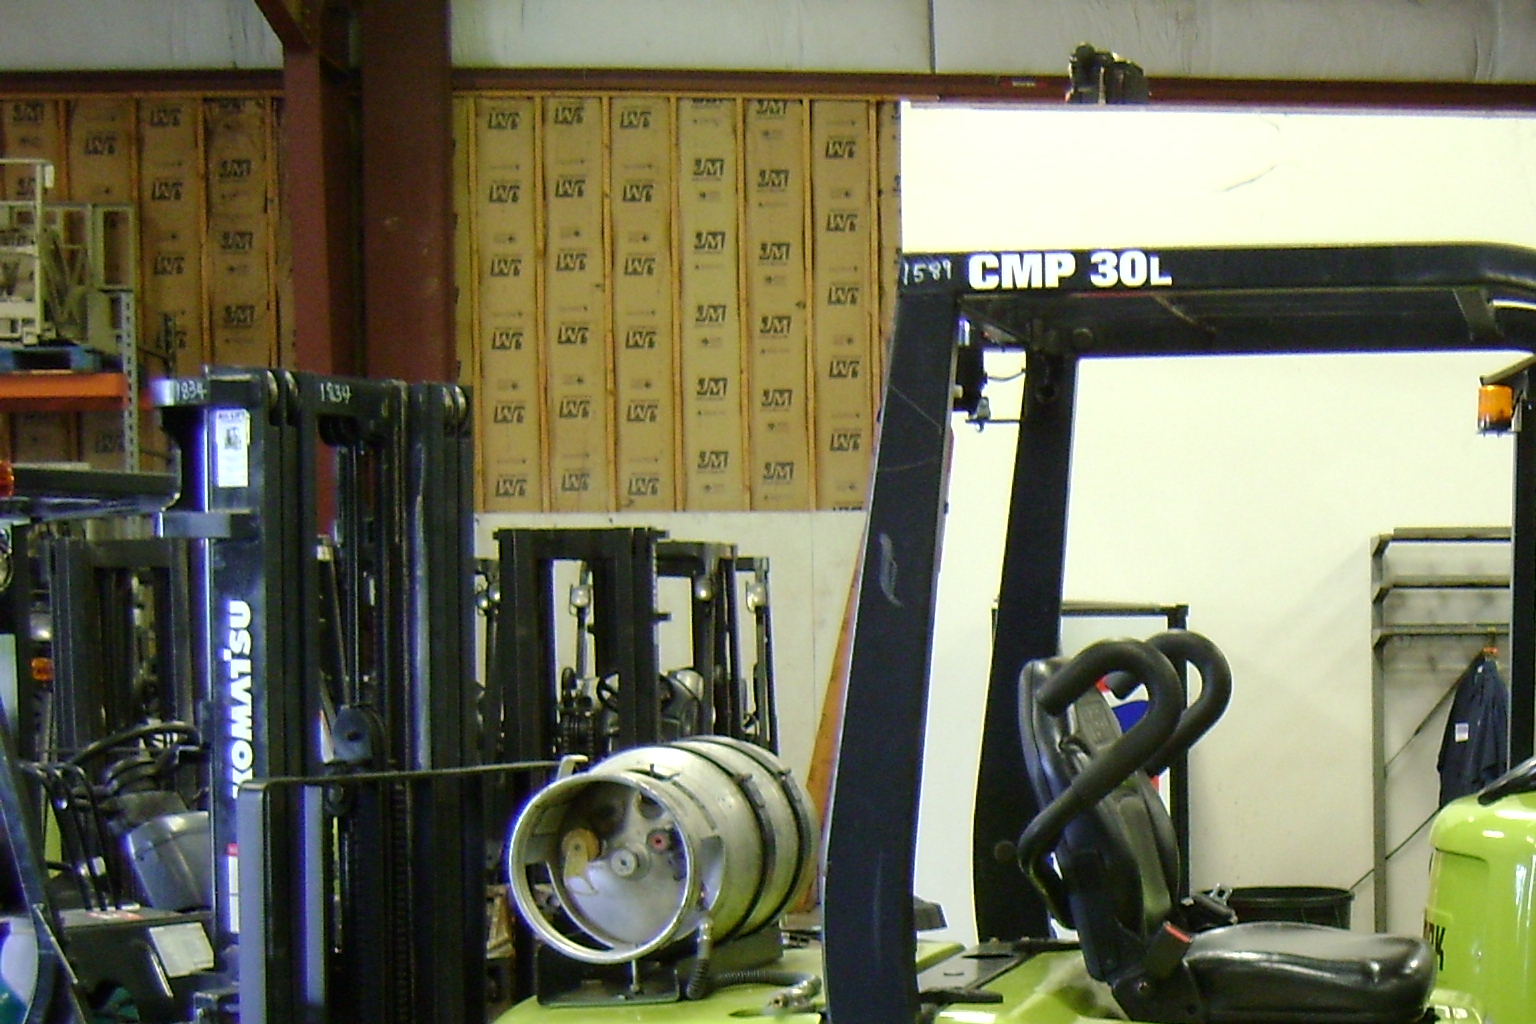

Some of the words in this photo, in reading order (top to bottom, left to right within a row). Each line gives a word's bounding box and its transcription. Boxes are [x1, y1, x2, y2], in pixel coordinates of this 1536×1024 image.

[968, 251, 1076, 290] CMP
[1090, 250, 1173, 288] 30L
[223, 600, 253, 799] KOMATSU
